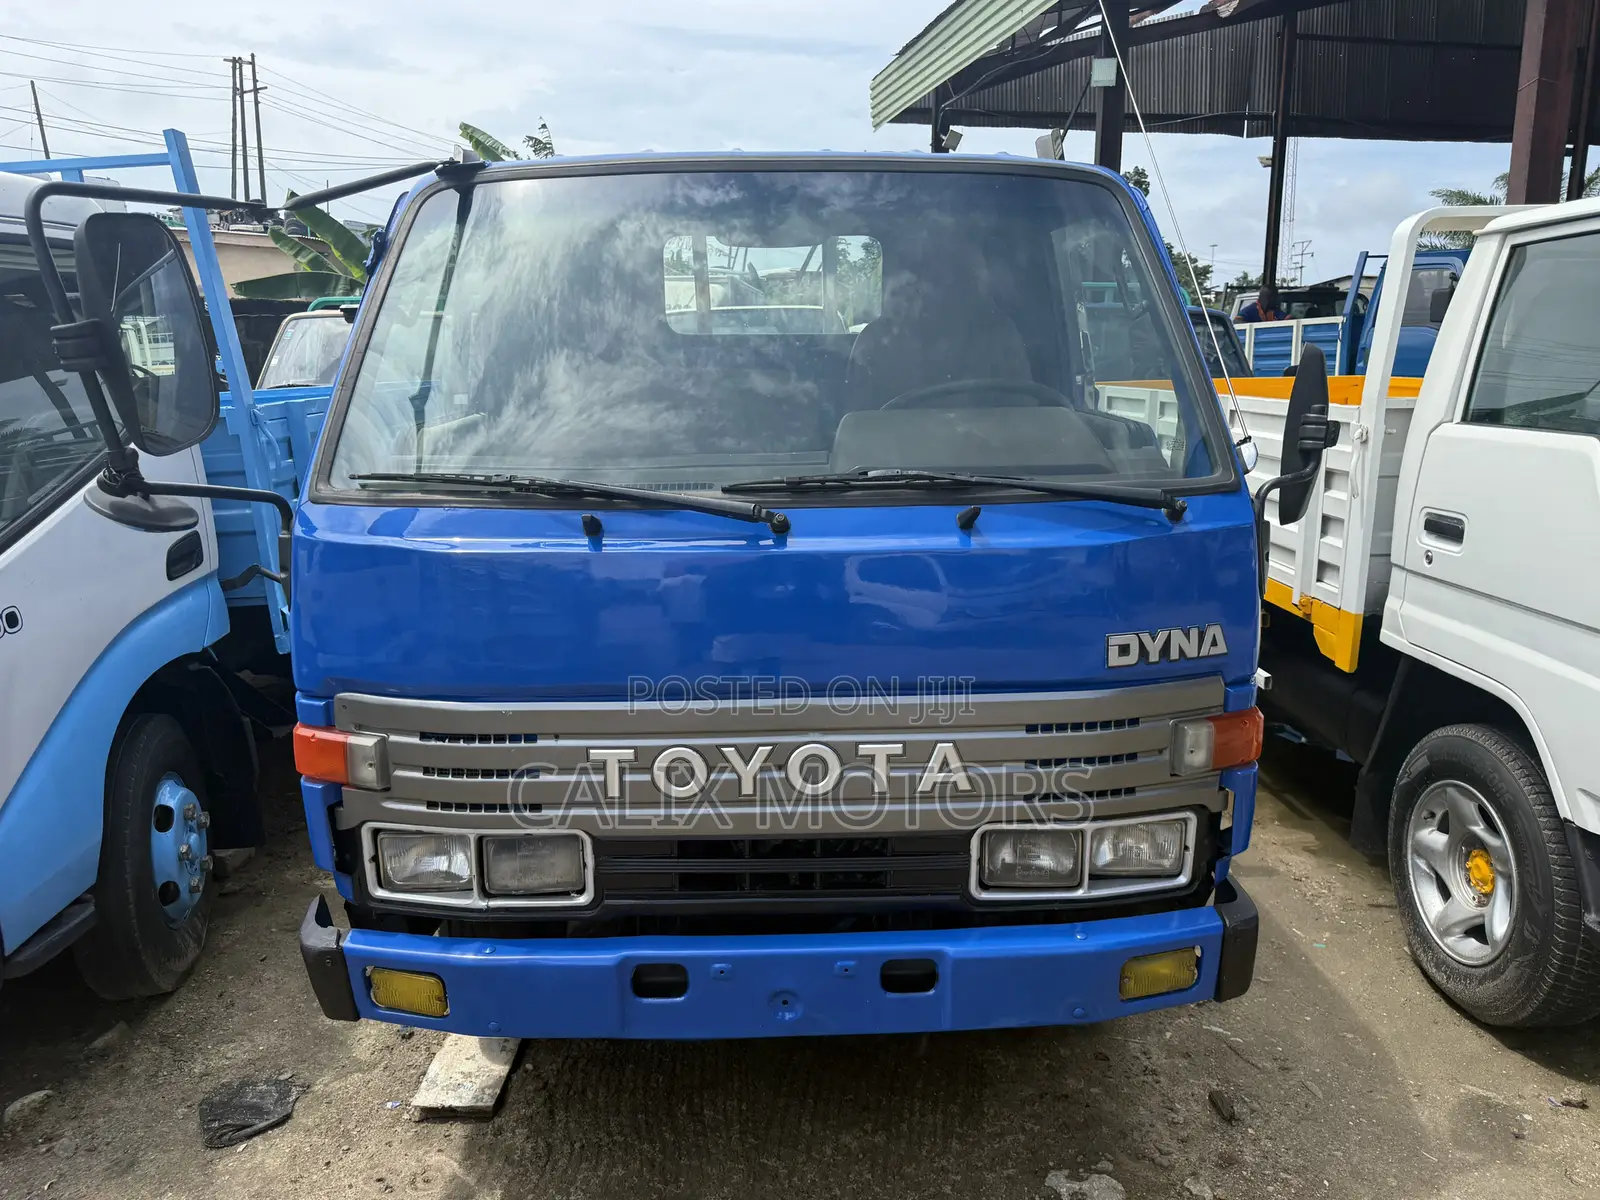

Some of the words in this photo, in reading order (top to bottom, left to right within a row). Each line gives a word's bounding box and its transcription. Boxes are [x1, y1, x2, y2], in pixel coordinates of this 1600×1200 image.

[0, 605, 23, 639] 0
[1105, 622, 1228, 668] DYNA
[586, 740, 976, 799] TOYOTA
